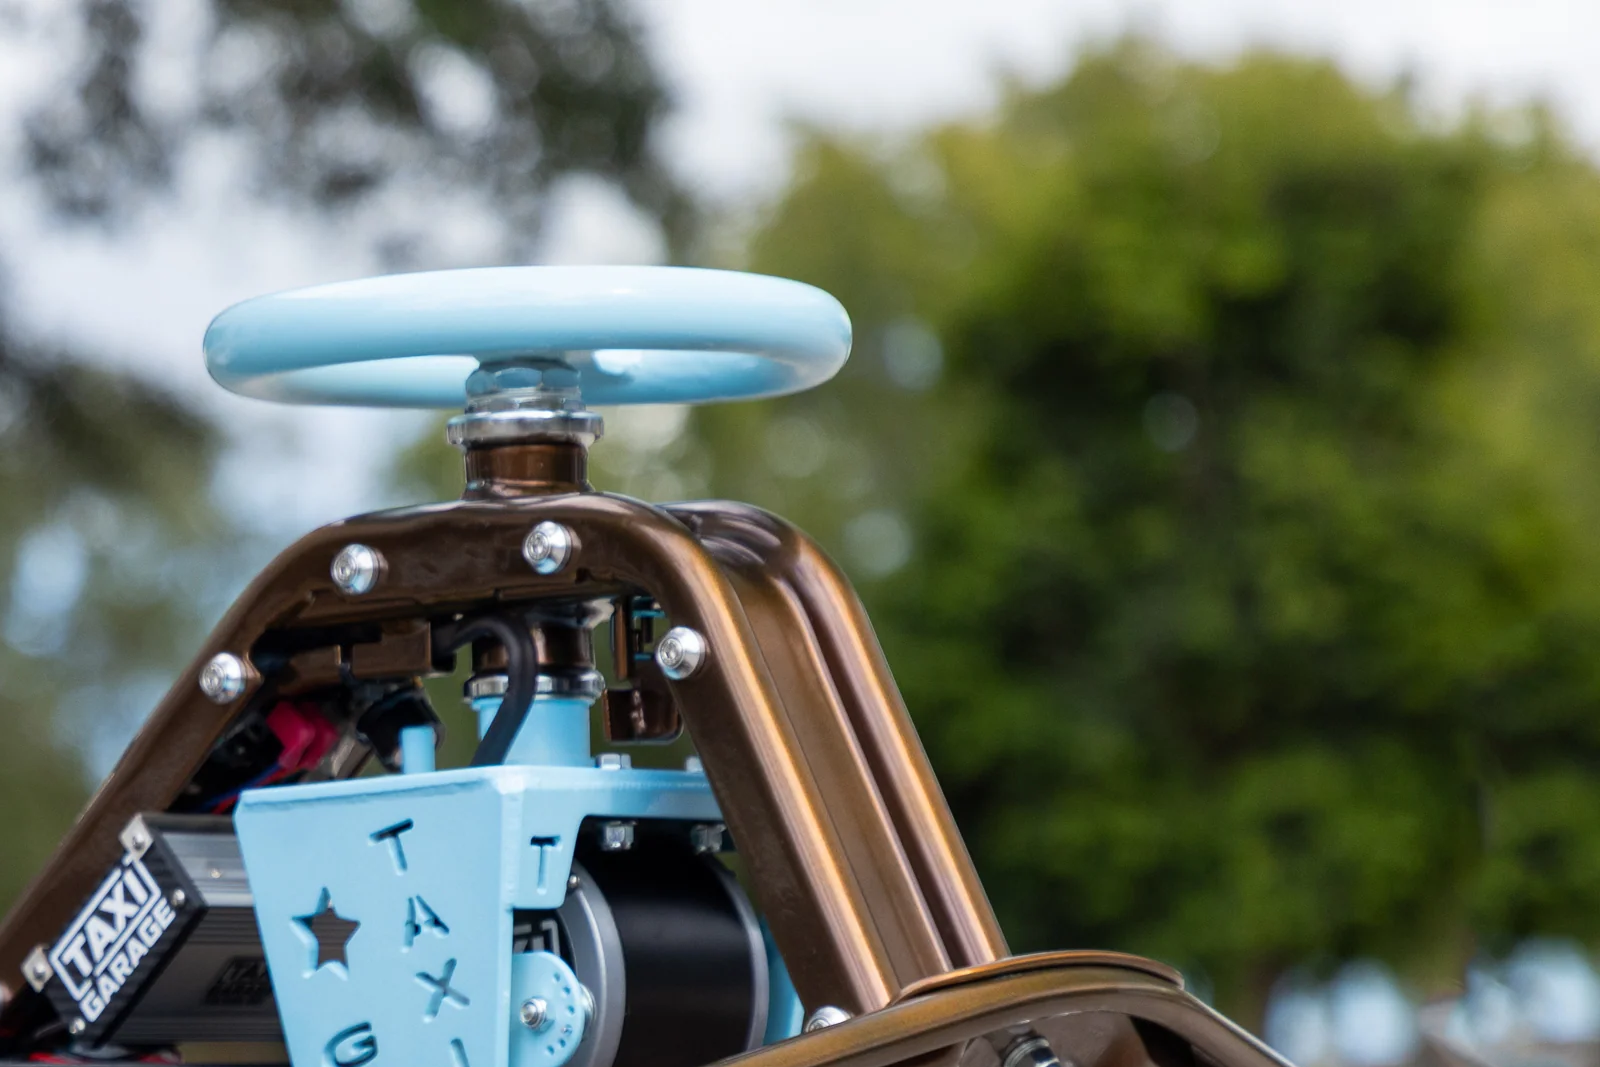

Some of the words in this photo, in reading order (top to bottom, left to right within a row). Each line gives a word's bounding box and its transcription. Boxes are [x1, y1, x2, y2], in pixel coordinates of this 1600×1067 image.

[529, 835, 562, 895] T
[60, 868, 150, 978] TAXI
[78, 896, 177, 1023] GARAGE
